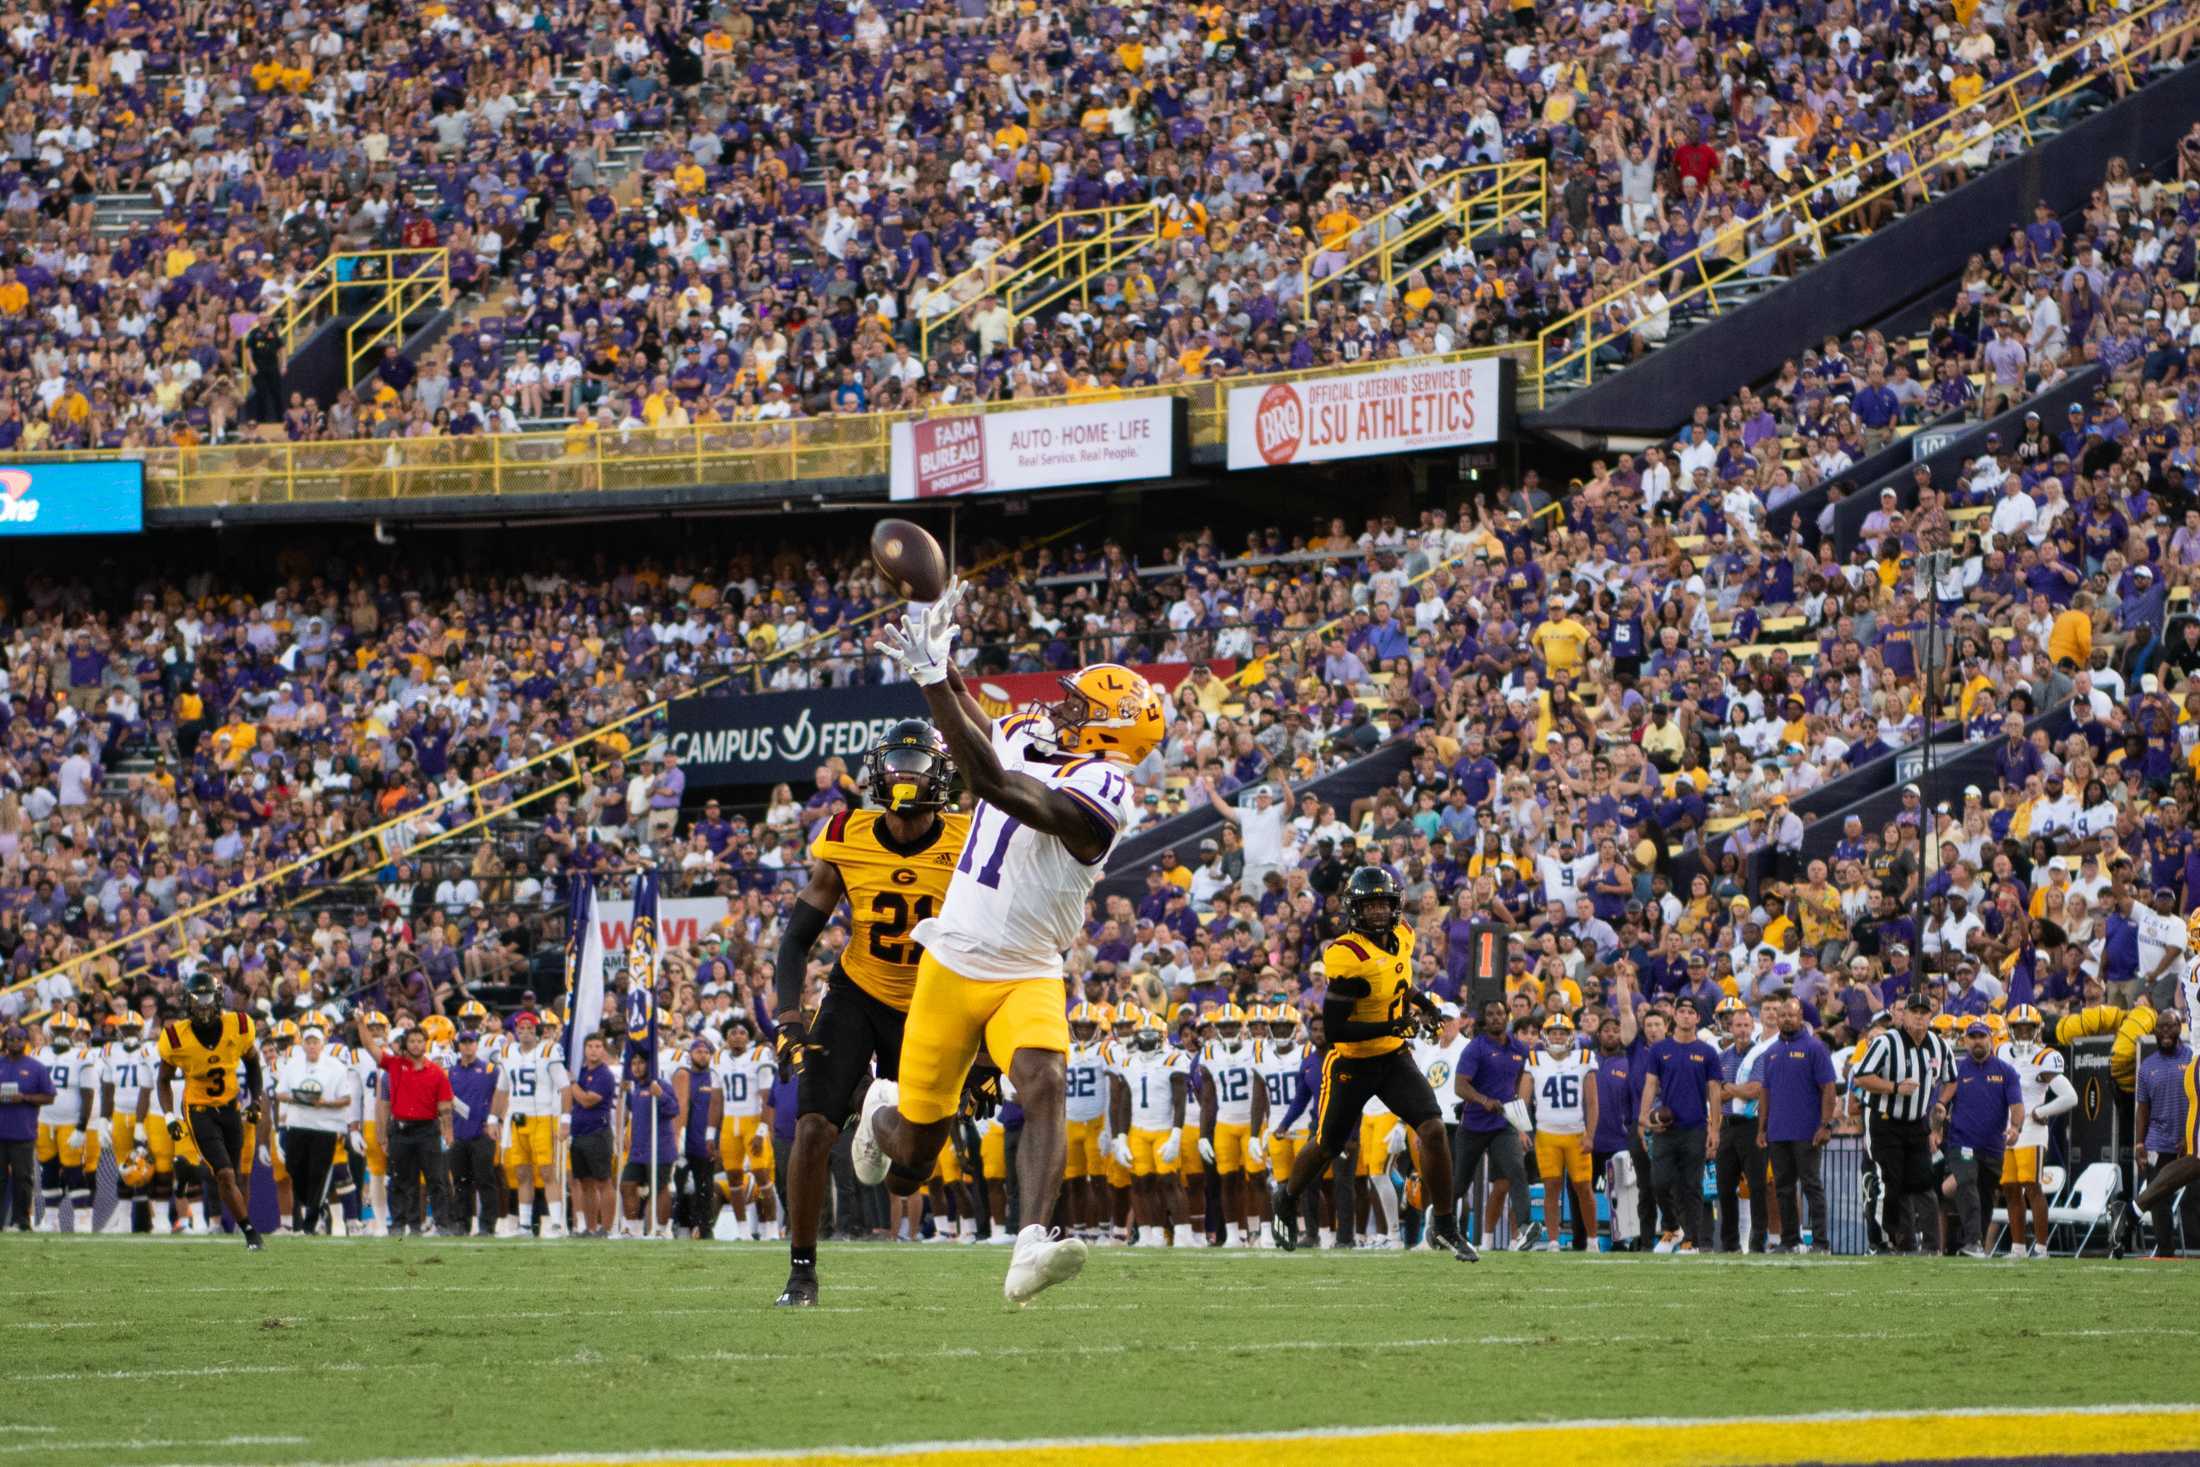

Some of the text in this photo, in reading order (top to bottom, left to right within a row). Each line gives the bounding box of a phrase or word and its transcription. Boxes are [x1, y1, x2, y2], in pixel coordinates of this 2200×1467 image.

[1309, 383, 1354, 405] OFFICIAL
[1358, 376, 1408, 399] CATERING
[1411, 370, 1456, 393] SERVICE
[1460, 368, 1473, 388] OF
[934, 418, 978, 447] FARM
[1010, 418, 1150, 450] AUTO HOME LIFE
[1309, 389, 1475, 446] LSU ATHLETICS
[919, 439, 979, 476] BUREAU
[1018, 454, 1038, 467] Real
[1080, 448, 1100, 463] Real
[931, 467, 981, 492] INSURANCE
[1615, 623, 1631, 642] 15
[671, 727, 774, 766] CAMPUS
[1098, 770, 1126, 806] 17
[1561, 868, 1573, 886] 9
[869, 890, 934, 966] 21
[1480, 932, 1493, 978] 1
[116, 1065, 137, 1088] 71
[206, 1067, 226, 1098] 3
[510, 1068, 536, 1097] 15
[723, 1073, 748, 1102] 10
[1141, 1075, 1149, 1108] 1
[1219, 1068, 1249, 1103] 12
[1265, 1071, 1299, 1106] 80
[1542, 1075, 1579, 1109] 46
